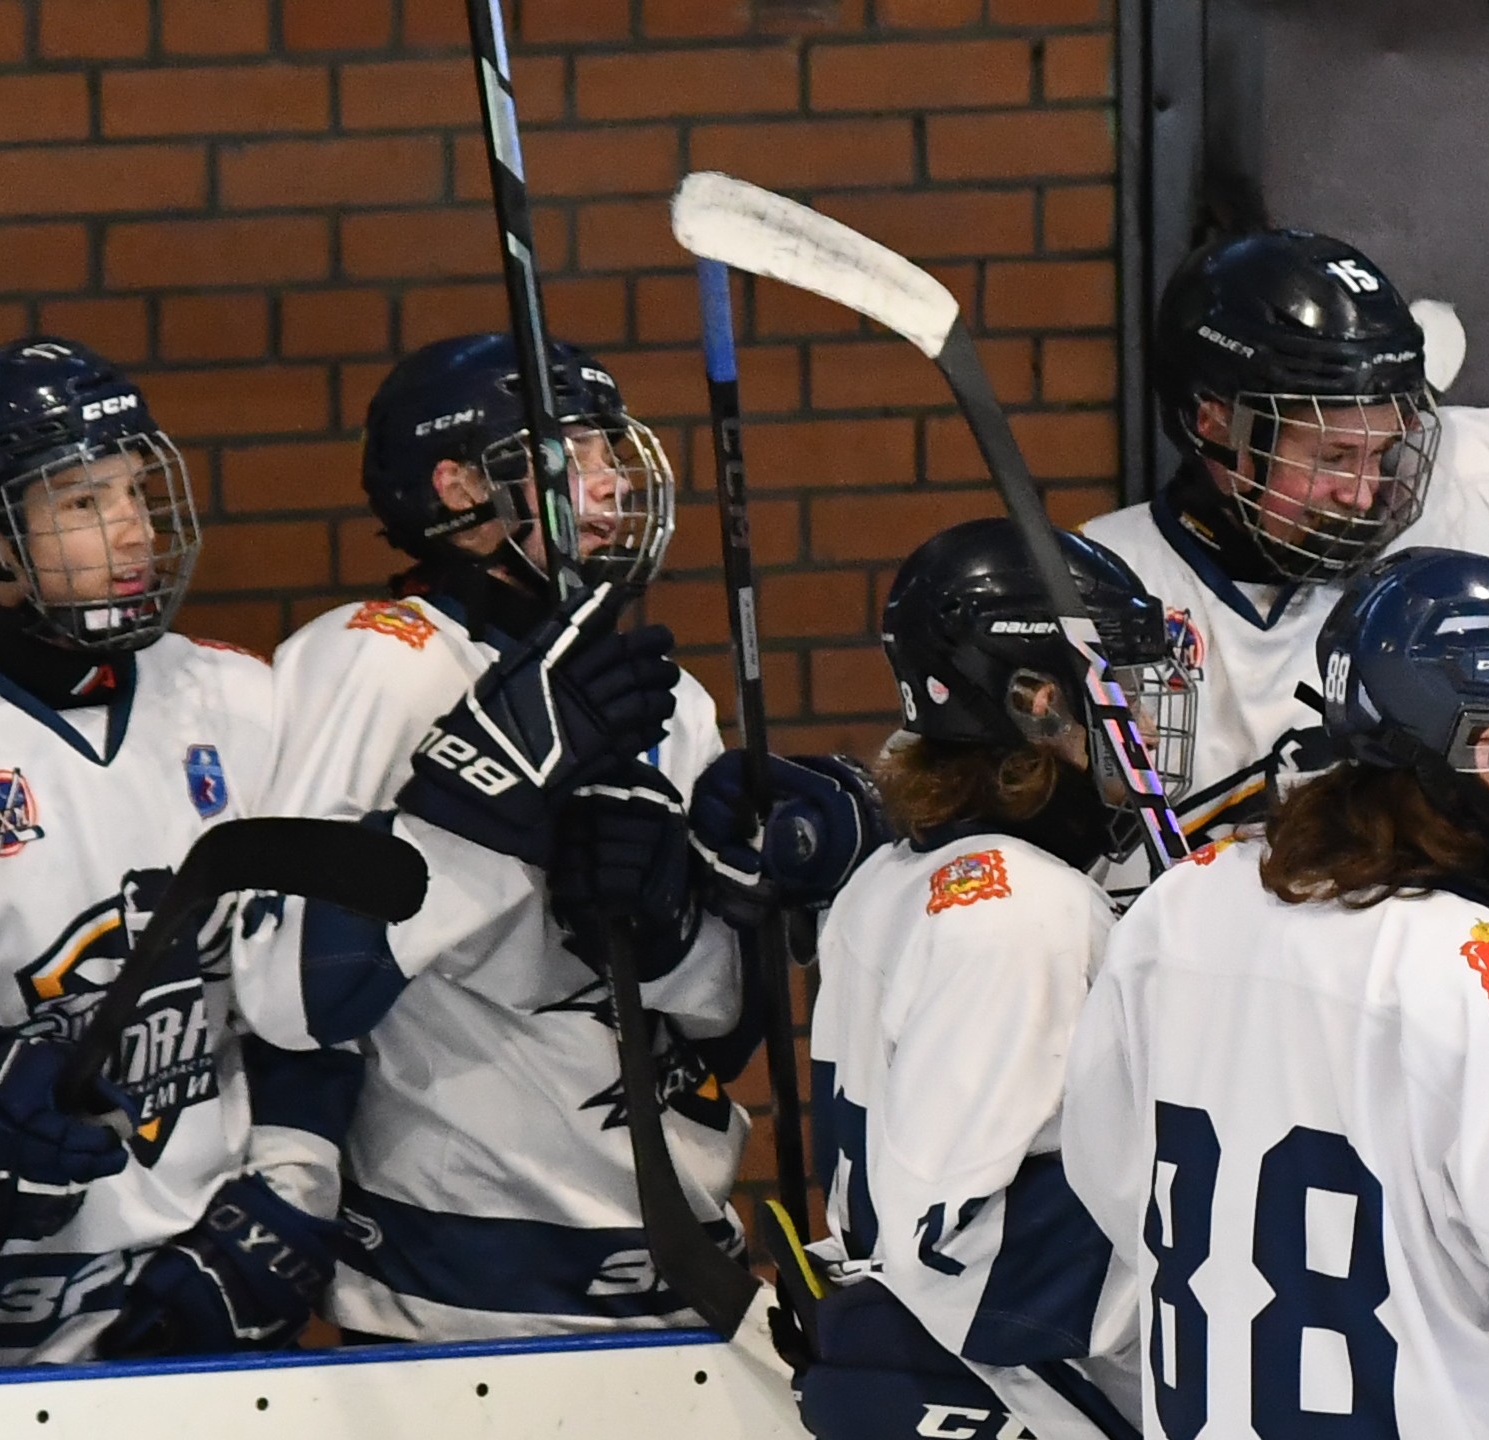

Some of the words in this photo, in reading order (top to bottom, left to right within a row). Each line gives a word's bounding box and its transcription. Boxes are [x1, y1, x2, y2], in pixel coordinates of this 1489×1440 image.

[1326, 259, 1379, 293] 15
[1197, 326, 1254, 359] BAUER
[581, 367, 616, 389] CC
[82, 394, 137, 421] CCM
[415, 409, 475, 436] CCM
[1326, 651, 1351, 704] 88
